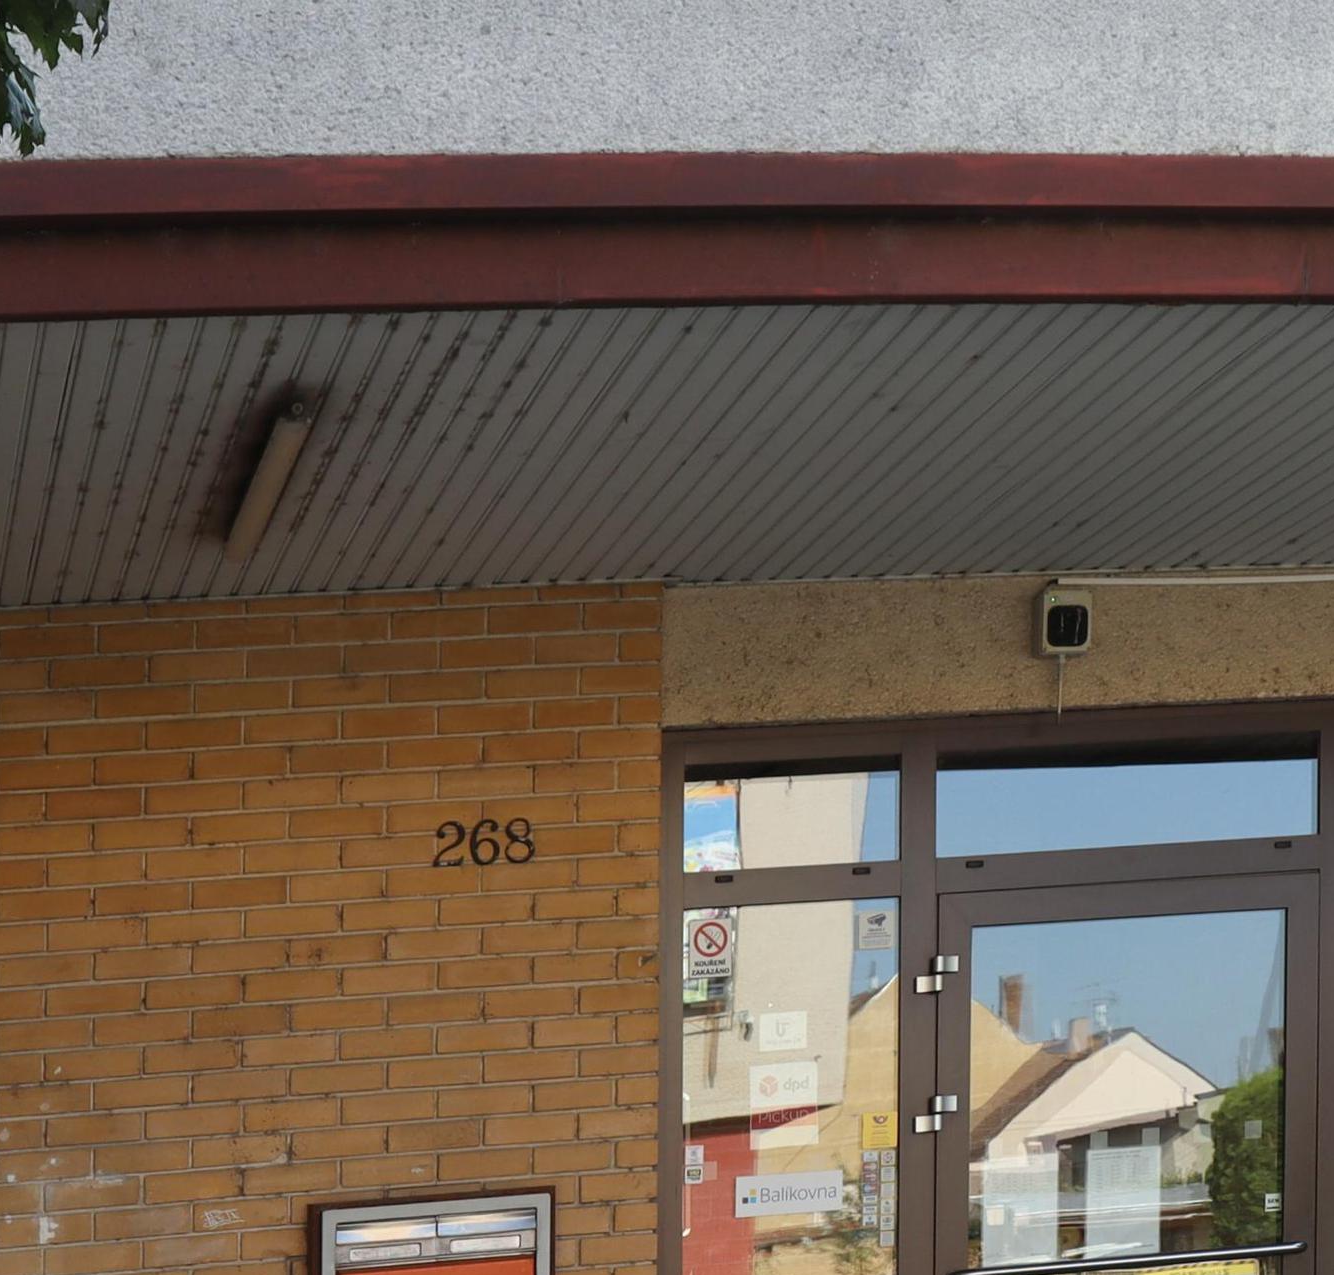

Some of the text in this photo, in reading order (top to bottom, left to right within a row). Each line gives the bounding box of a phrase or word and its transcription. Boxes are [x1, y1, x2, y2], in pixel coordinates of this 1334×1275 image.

[433, 818, 535, 867] 268
[783, 1076, 810, 1093] dpd
[760, 1186, 837, 1203] Balíkovna
